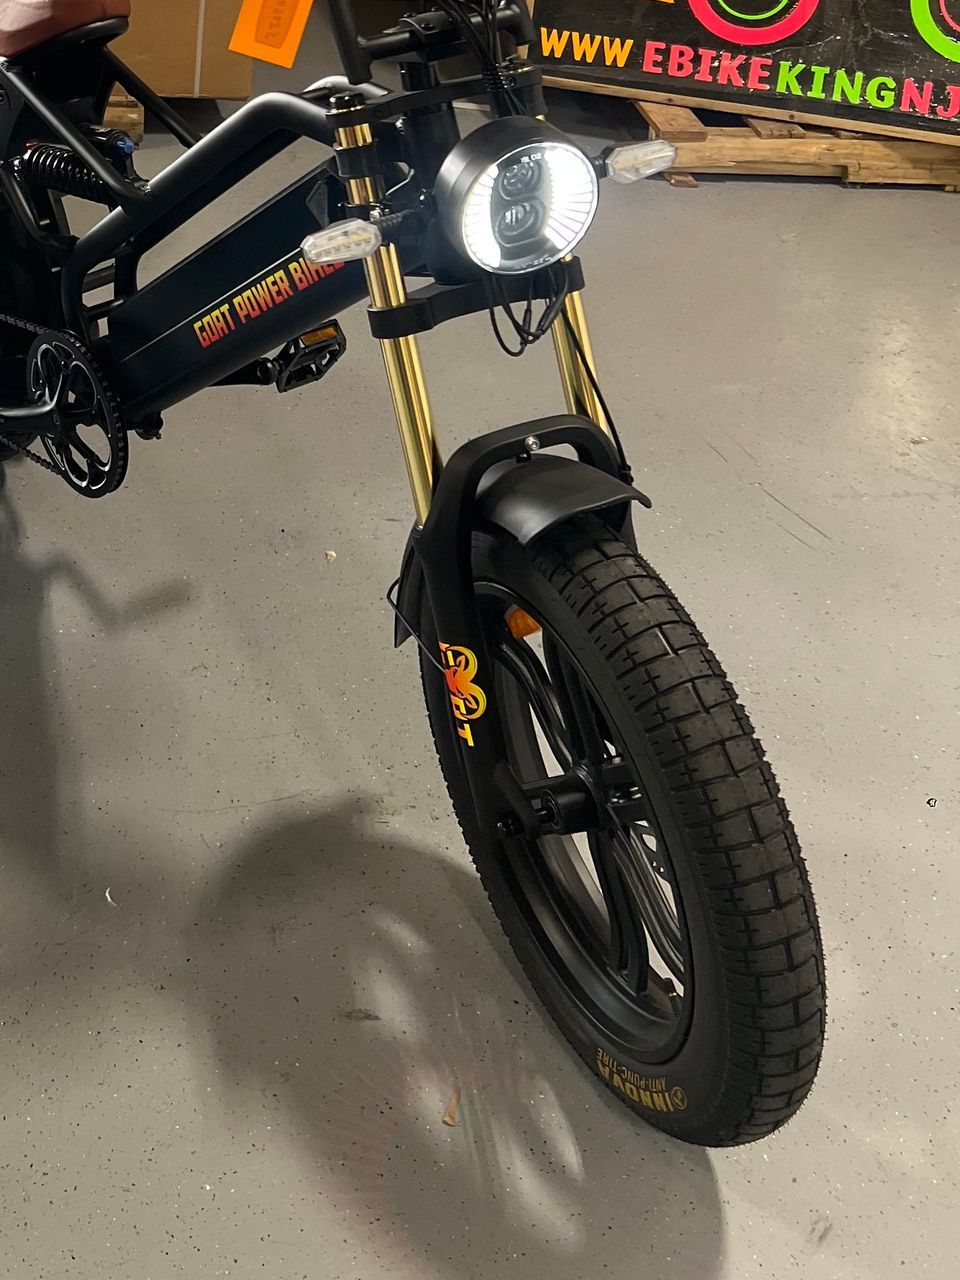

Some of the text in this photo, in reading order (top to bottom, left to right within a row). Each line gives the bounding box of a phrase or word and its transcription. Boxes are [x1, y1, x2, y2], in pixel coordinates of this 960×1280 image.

[540, 27, 633, 67] WWW
[193, 303, 236, 349] GOAT
[232, 269, 294, 324] POWER
[597, 1060, 674, 1112] INNOVA
